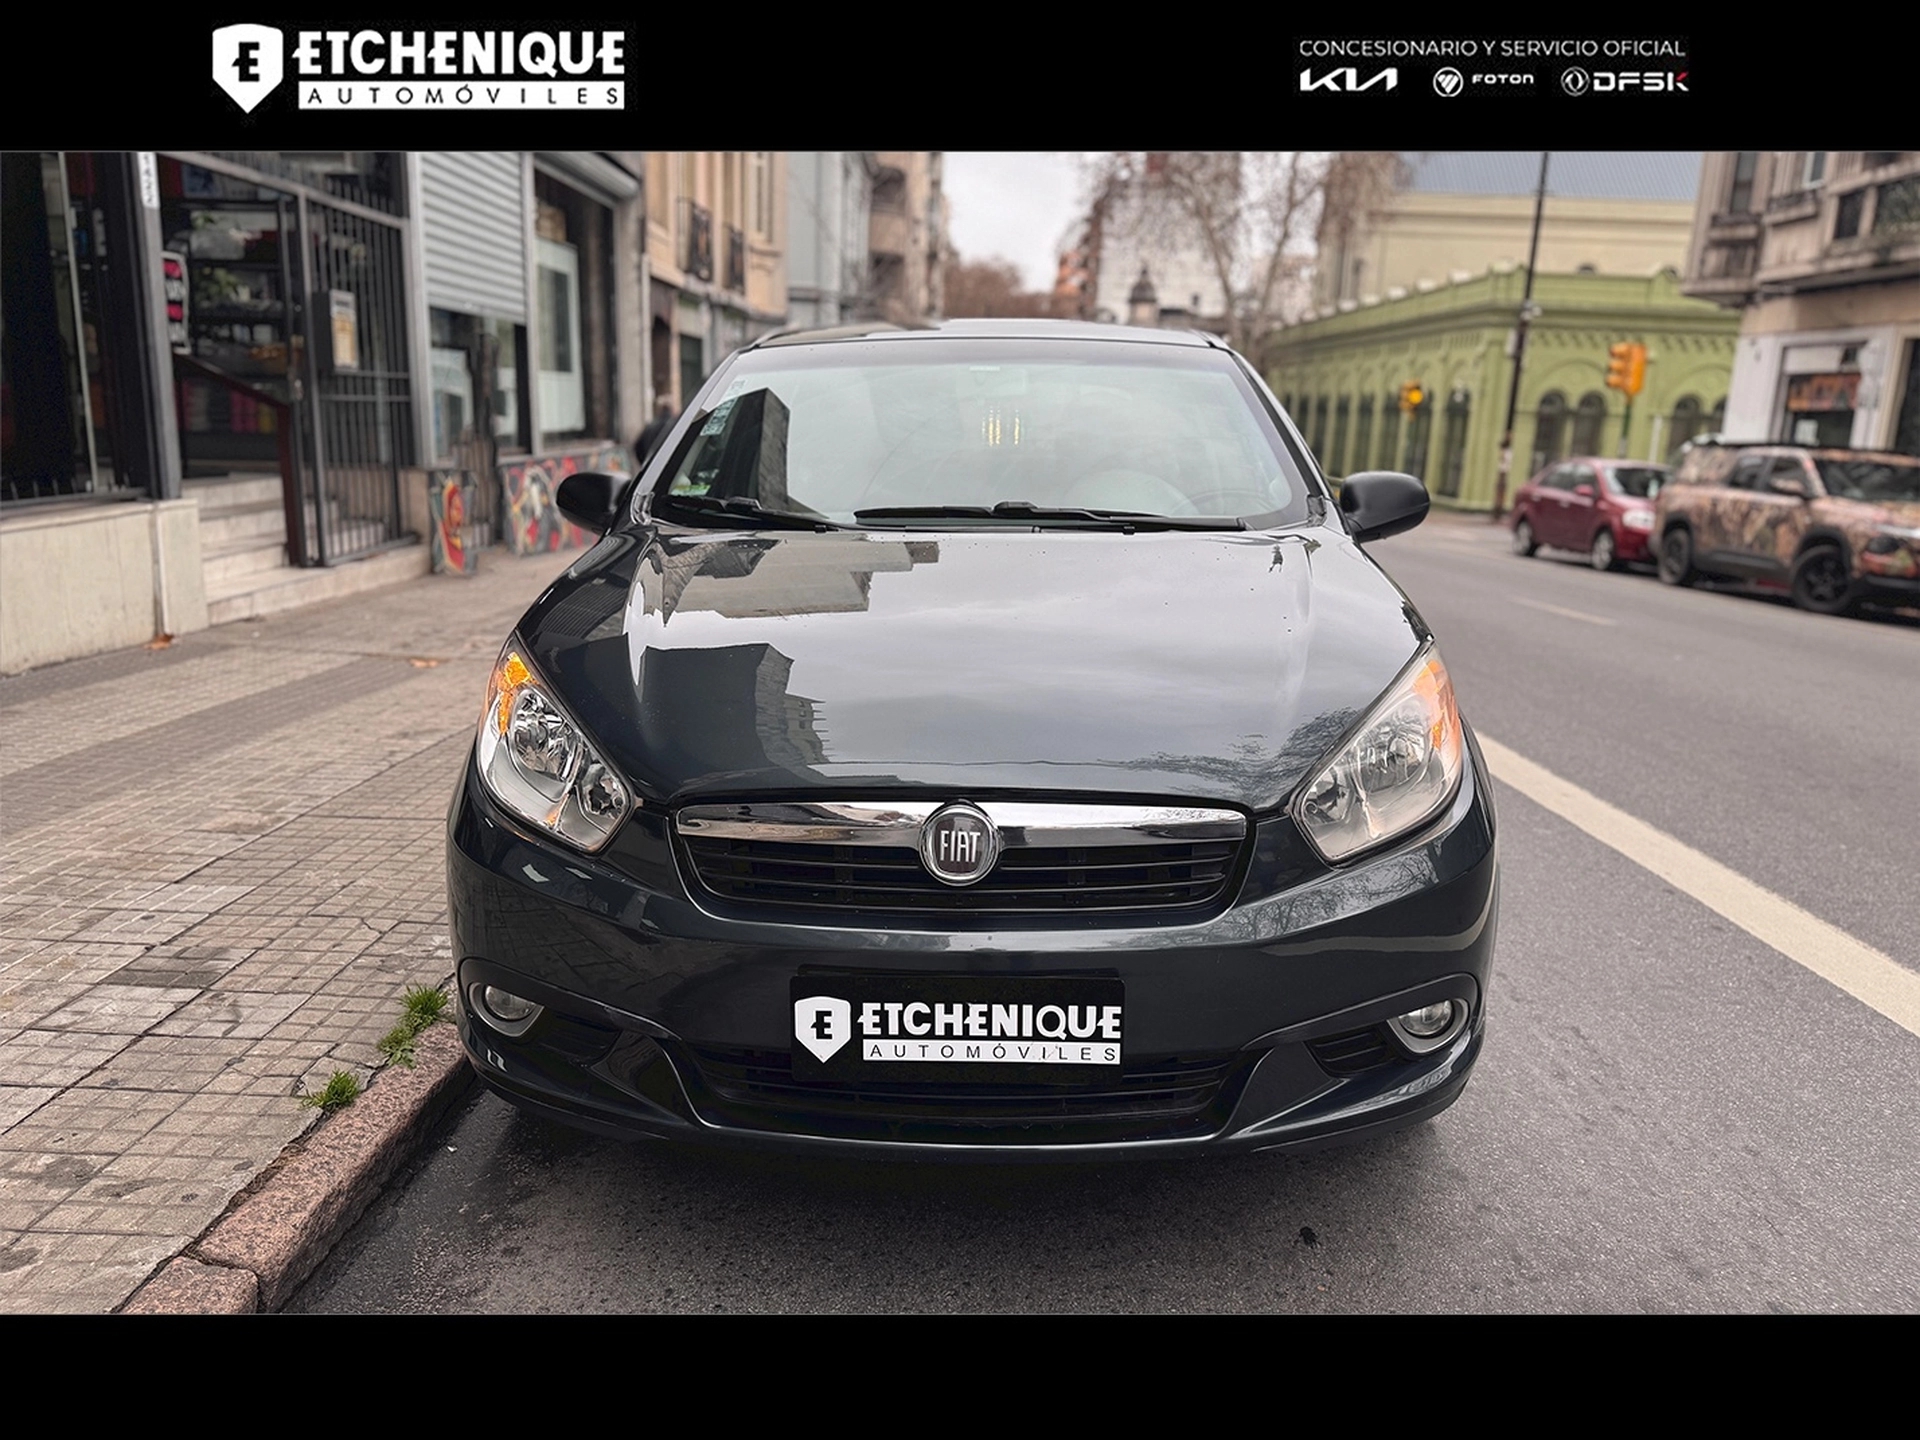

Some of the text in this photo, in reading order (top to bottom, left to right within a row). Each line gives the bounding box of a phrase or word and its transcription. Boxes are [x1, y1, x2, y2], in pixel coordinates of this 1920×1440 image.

[941, 830, 981, 862] FIAT
[857, 1002, 1122, 1040] ETCHENIQUE
[870, 1043, 1116, 1061] AUTOMÓVILES
